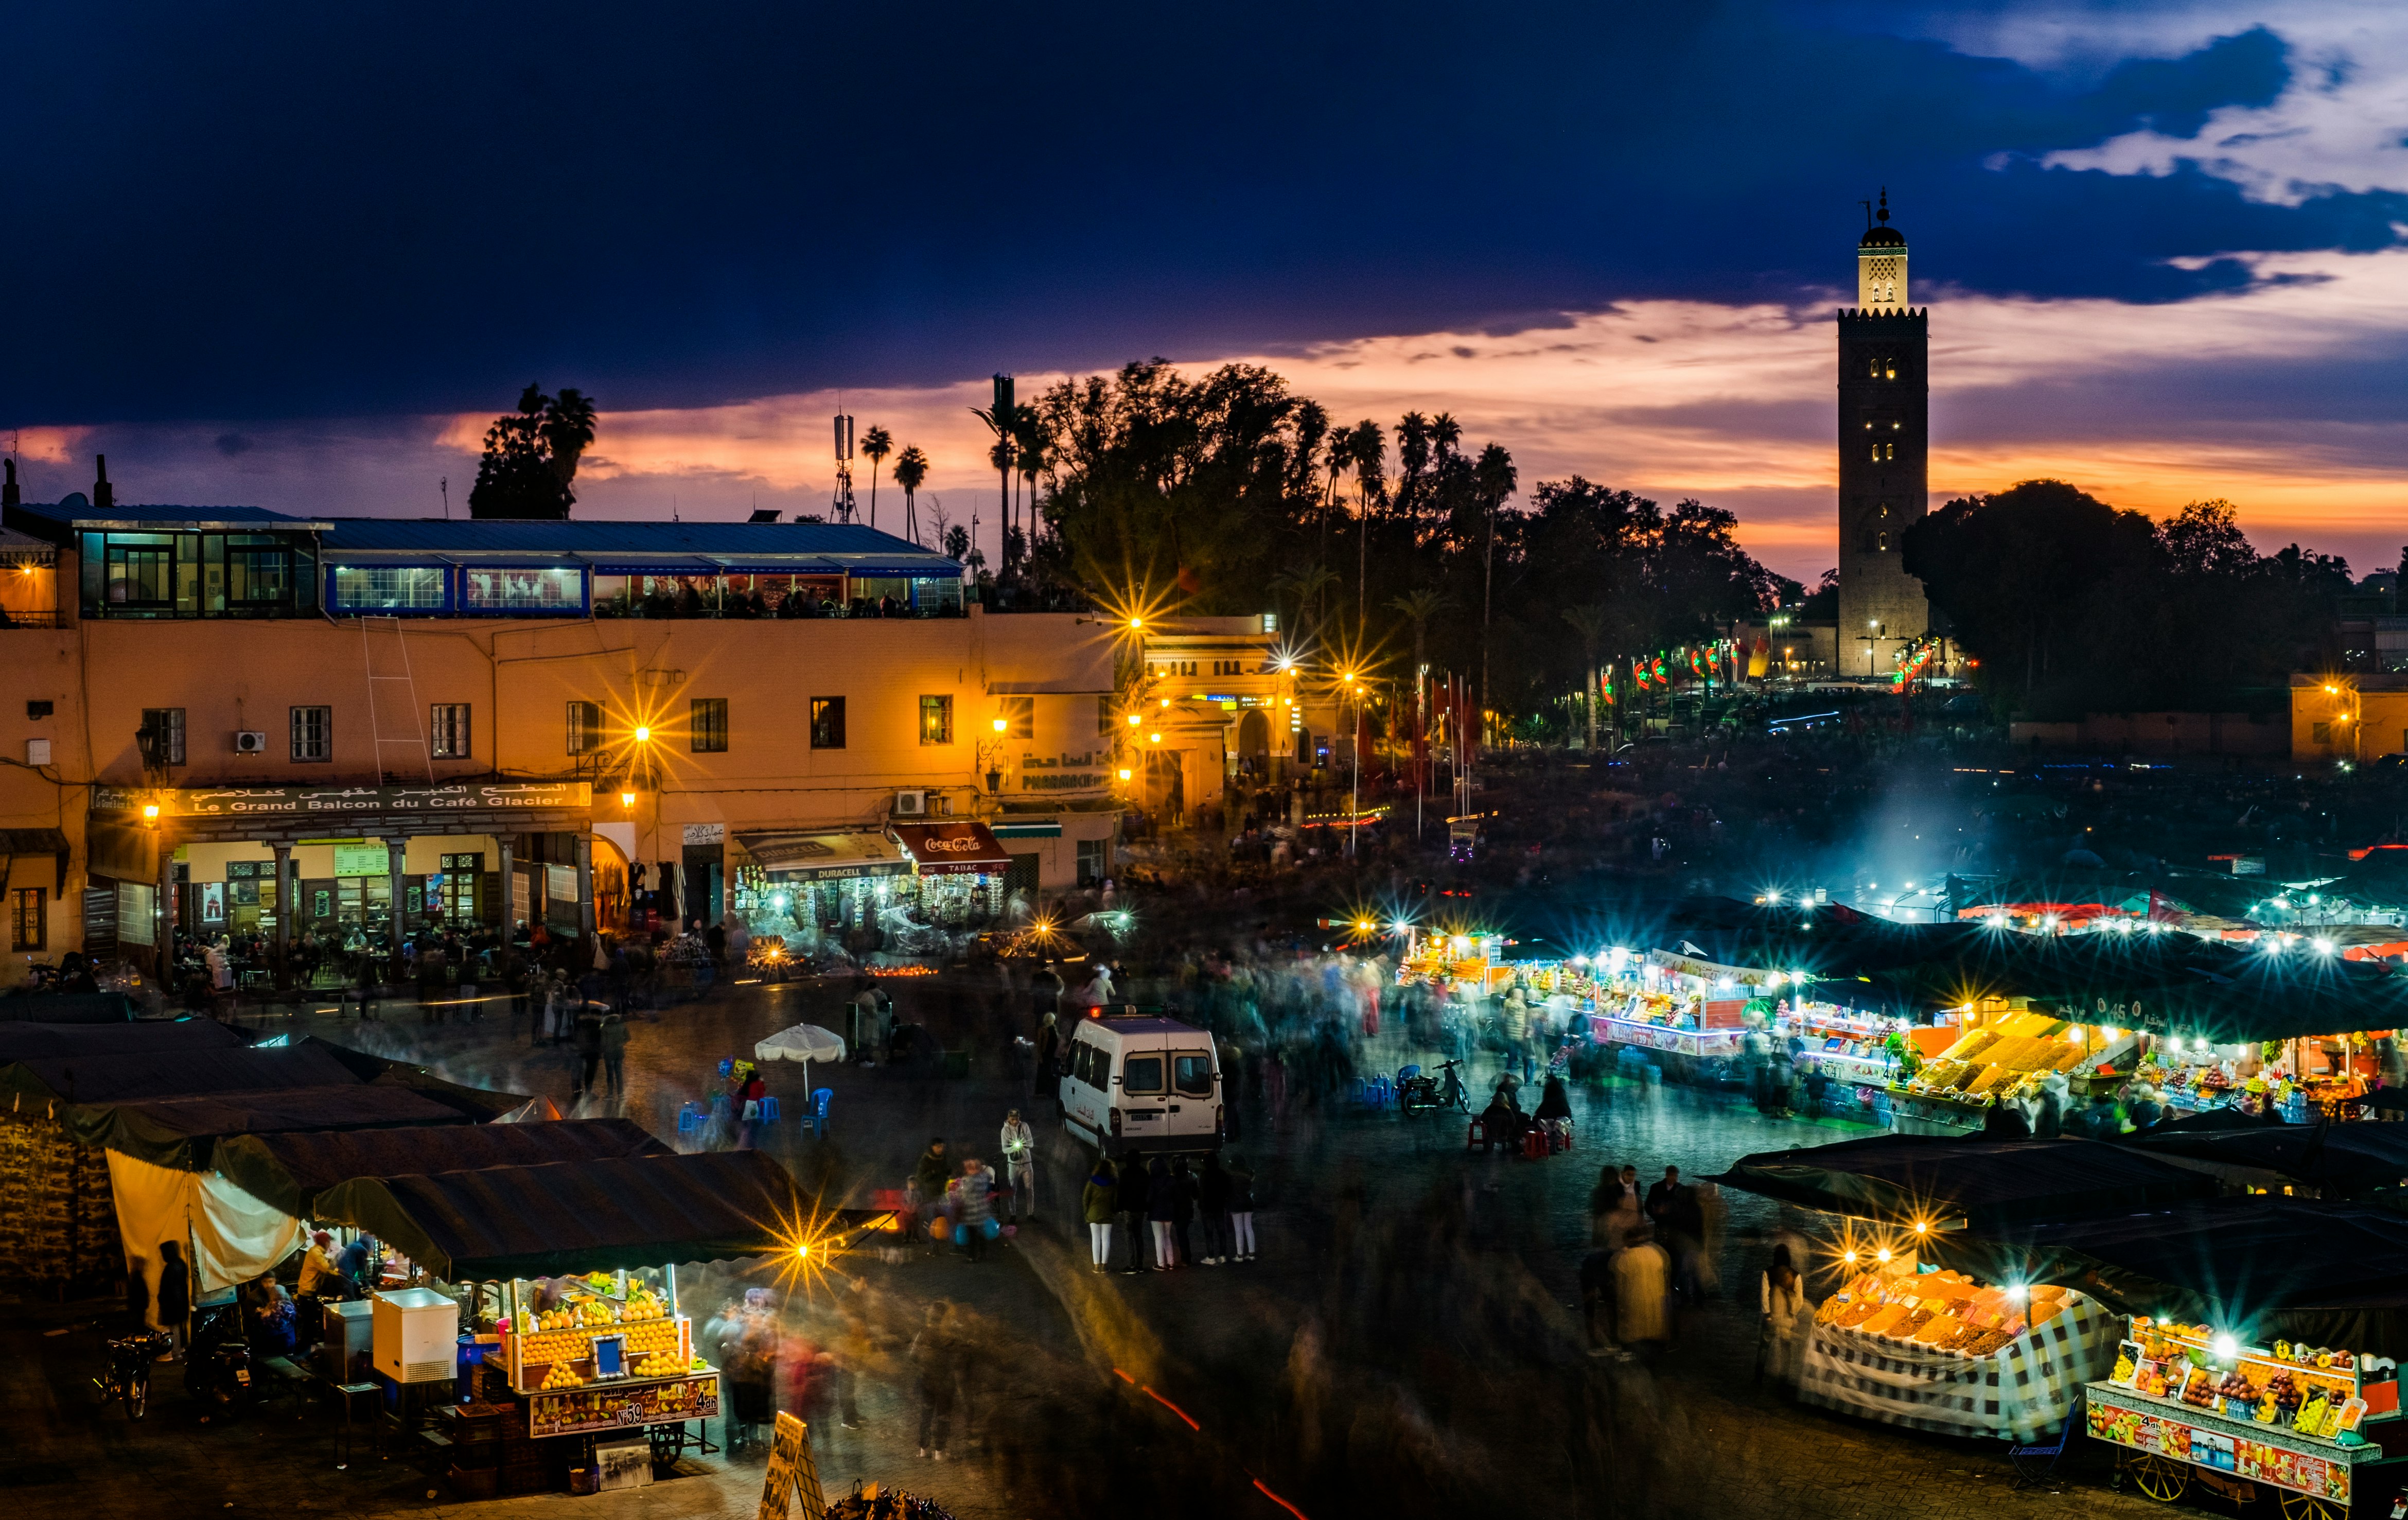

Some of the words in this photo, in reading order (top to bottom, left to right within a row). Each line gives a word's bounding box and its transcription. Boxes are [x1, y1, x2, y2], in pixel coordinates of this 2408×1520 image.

[1022, 774, 1093, 790] PHARMACIE
[391, 785, 467, 796] الكبير
[480, 784, 567, 796] السطح
[194, 803, 220, 812] Le
[230, 801, 296, 811] Grand
[308, 800, 380, 809] Balcon
[392, 799, 418, 808] du
[430, 798, 477, 807] Café
[487, 797, 563, 806] Glacier
[757, 843, 823, 858] DURACELL
[925, 836, 980, 852] Coca-Cola
[818, 868, 861, 878] DURACELL
[2111, 1004, 2125, 1020] 45
[1638, 1034, 1647, 1044] 39
[696, 1391, 716, 1409] 4dh
[2141, 1416, 2160, 1430] 4dh
